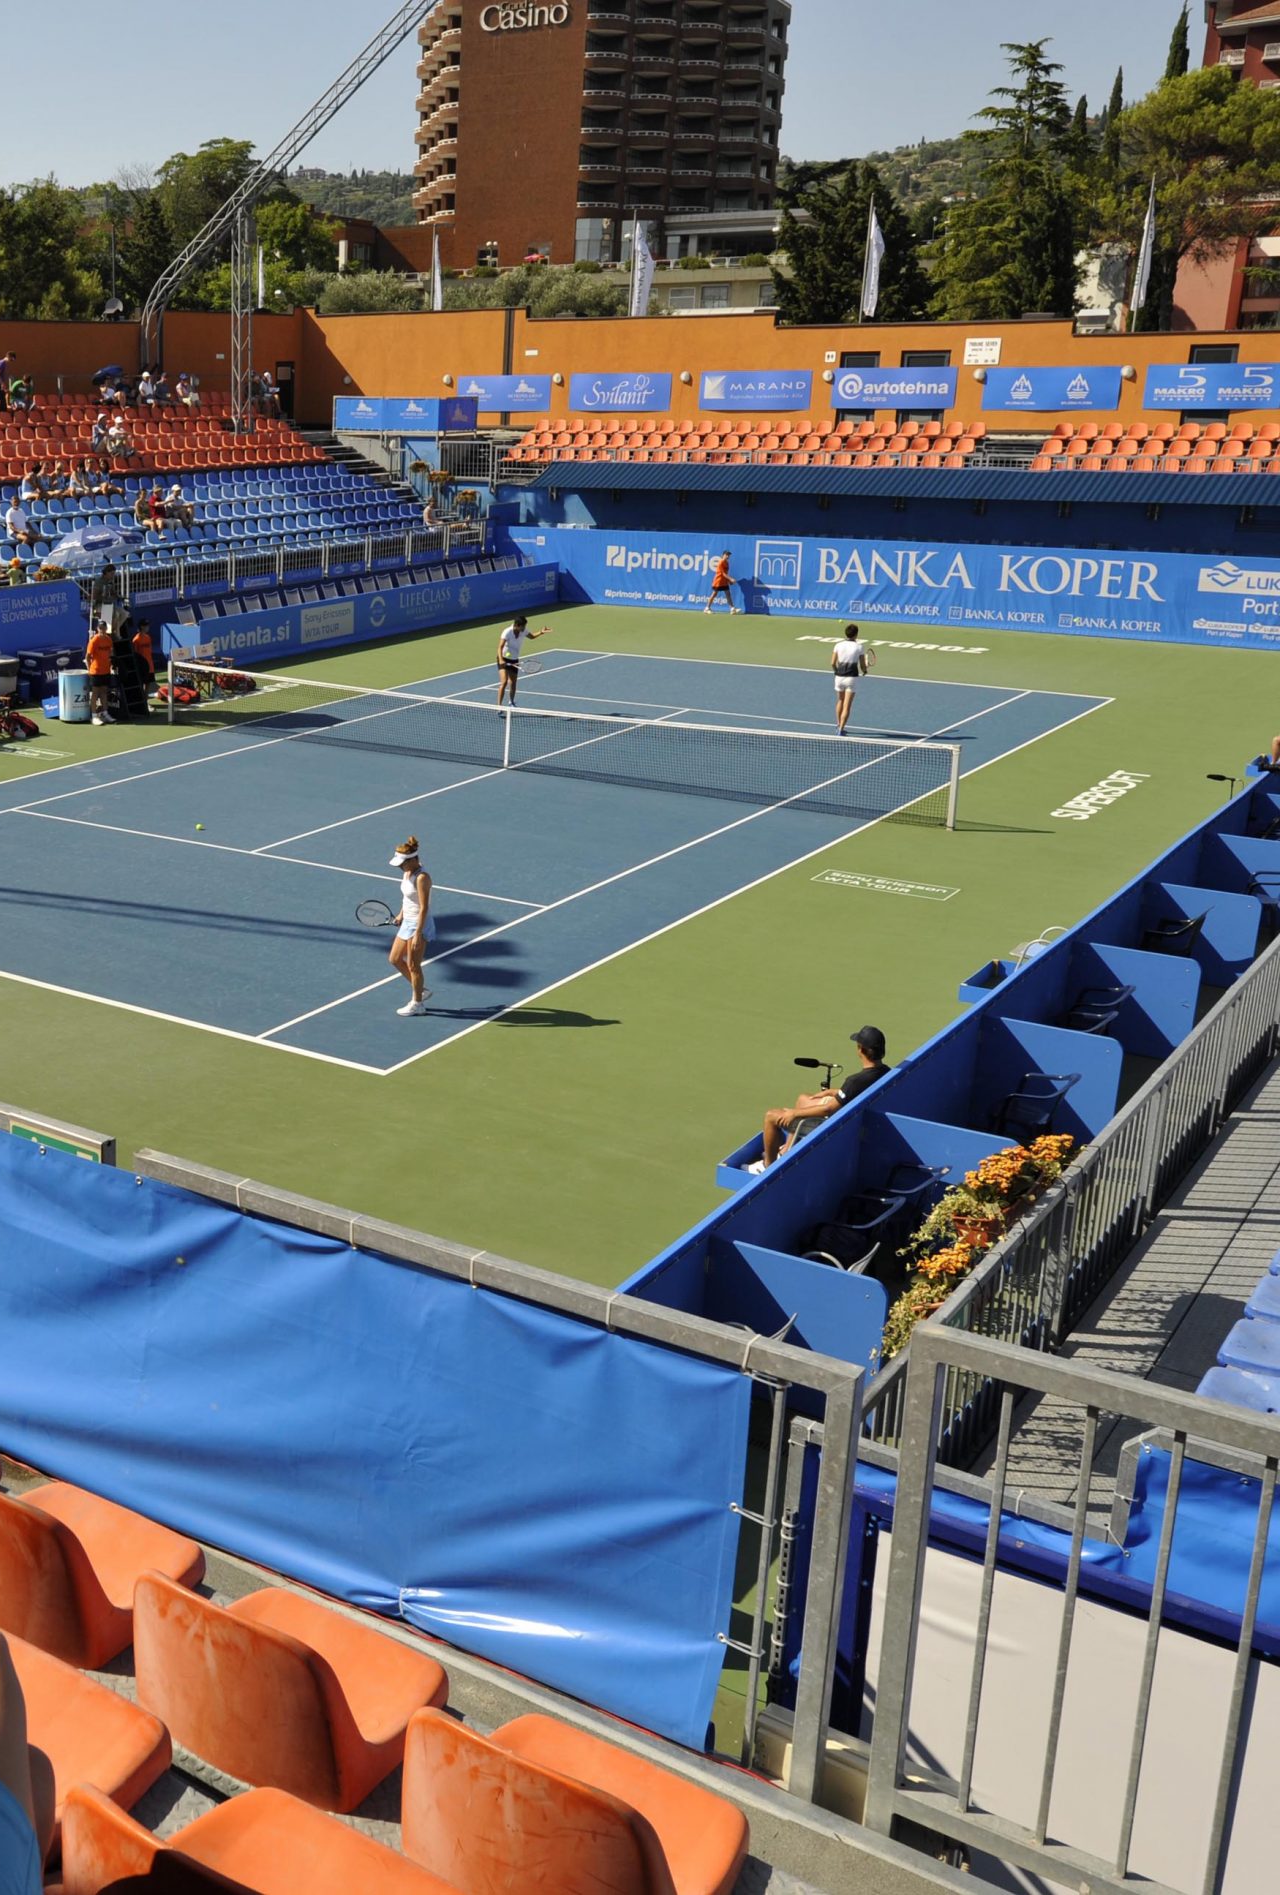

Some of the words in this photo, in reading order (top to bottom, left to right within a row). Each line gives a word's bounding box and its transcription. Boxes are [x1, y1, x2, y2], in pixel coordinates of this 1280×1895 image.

[1178, 367, 1207, 388] 5
[1243, 366, 1274, 388] 5
[583, 380, 655, 405] Svilanit
[729, 381, 807, 391] MARAND
[1217, 387, 1273, 395] MAKRO
[626, 547, 721, 576] primorje
[816, 548, 976, 589] BANKA
[996, 554, 1167, 602] KOPER
[11, 595, 39, 609] BANKA
[41, 592, 68, 605] KOPER
[611, 590, 642, 600] primorje
[650, 592, 684, 602] primorje
[767, 598, 801, 609] BANKA
[804, 599, 839, 612] KOPER
[864, 602, 901, 614] BANKA
[904, 604, 941, 617] KOPER
[304, 612, 322, 624] Sony
[323, 607, 352, 620] Ericsson
[965, 609, 1003, 621] BANKA
[1007, 611, 1046, 624] KOPER
[1077, 617, 1118, 630] BANKA
[1121, 619, 1162, 633] KOPER
[1049, 769, 1152, 821] SUPERSOFT
[824, 875, 861, 886] WTA
[866, 882, 913, 894] TOUR
[829, 871, 872, 883] Sony
[874, 878, 948, 894] Ericsson
